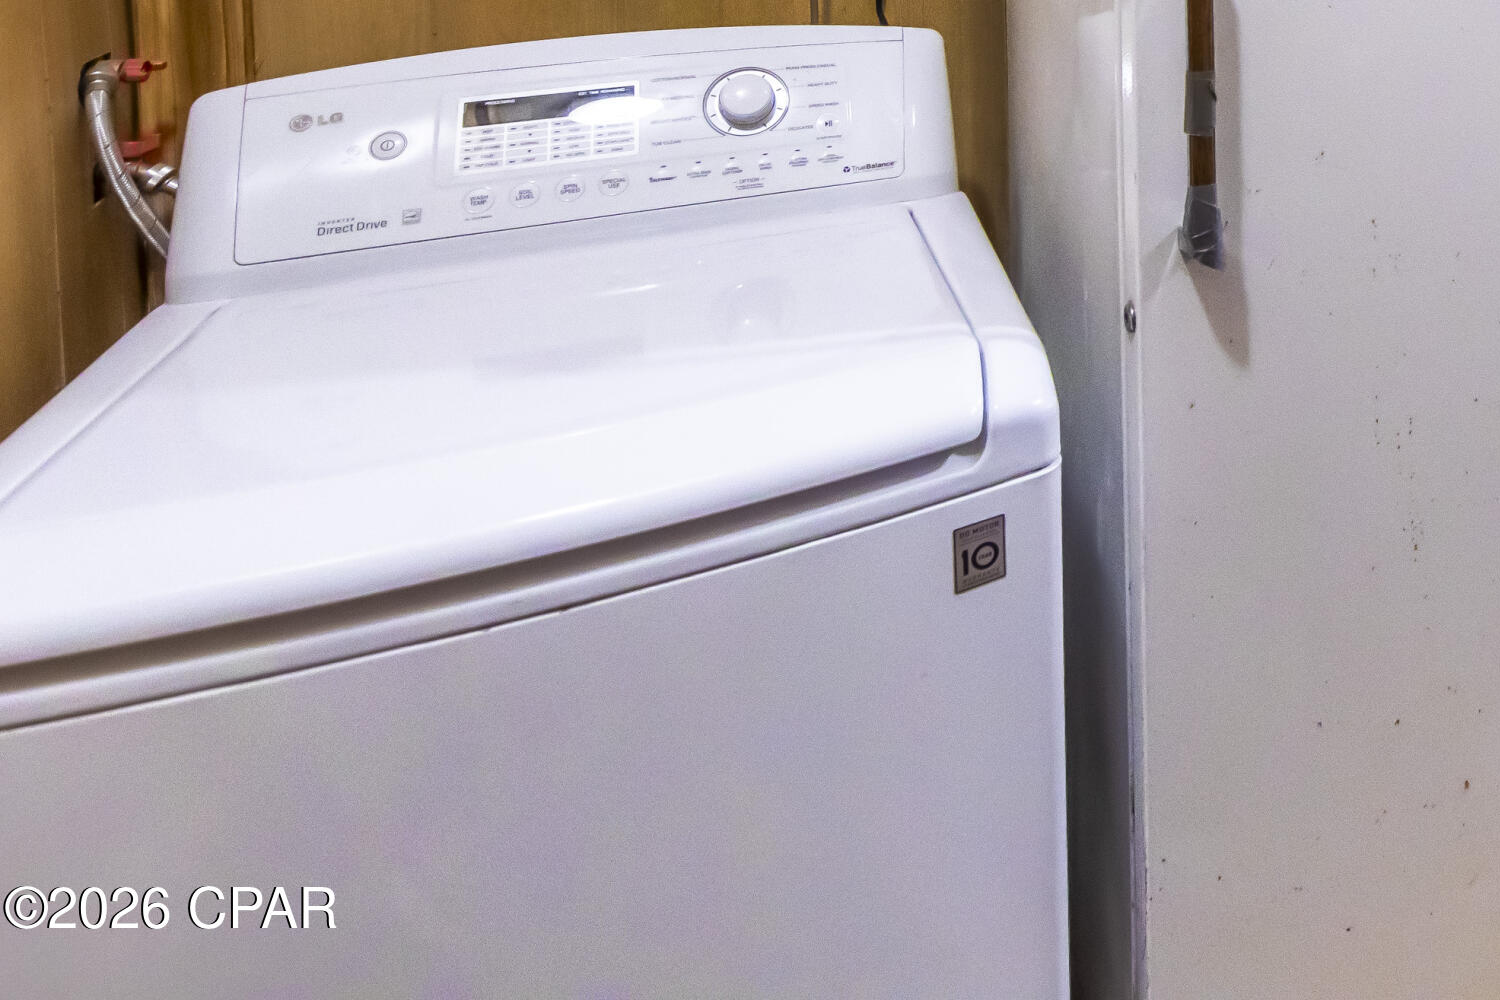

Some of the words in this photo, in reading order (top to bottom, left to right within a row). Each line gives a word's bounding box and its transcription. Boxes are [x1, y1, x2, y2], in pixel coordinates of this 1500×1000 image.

[317, 112, 344, 126] LG
[851, 160, 896, 172] TrueBalance
[316, 223, 353, 237] Direct
[356, 219, 388, 231] Drive
[961, 541, 1000, 576] 10
